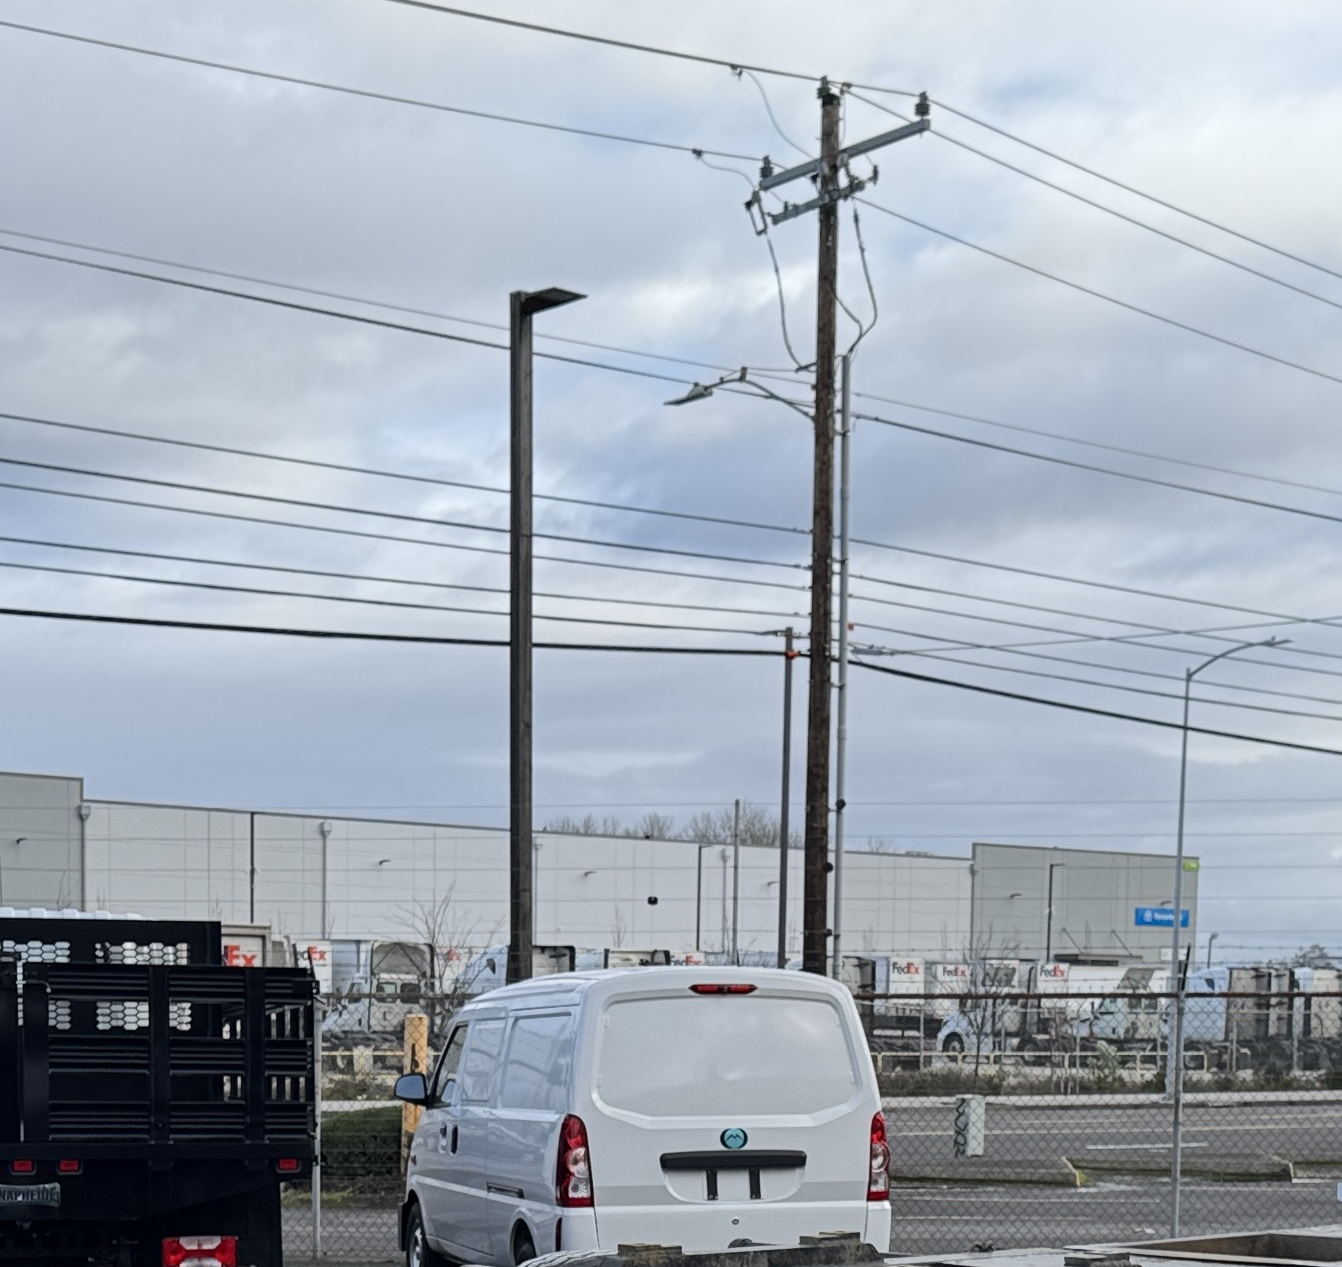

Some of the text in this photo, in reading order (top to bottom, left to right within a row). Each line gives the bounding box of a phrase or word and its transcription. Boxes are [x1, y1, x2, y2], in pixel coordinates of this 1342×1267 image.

[892, 961, 920, 975] FedEx
[943, 965, 967, 978] FedEx
[1040, 963, 1066, 978] FedEx
